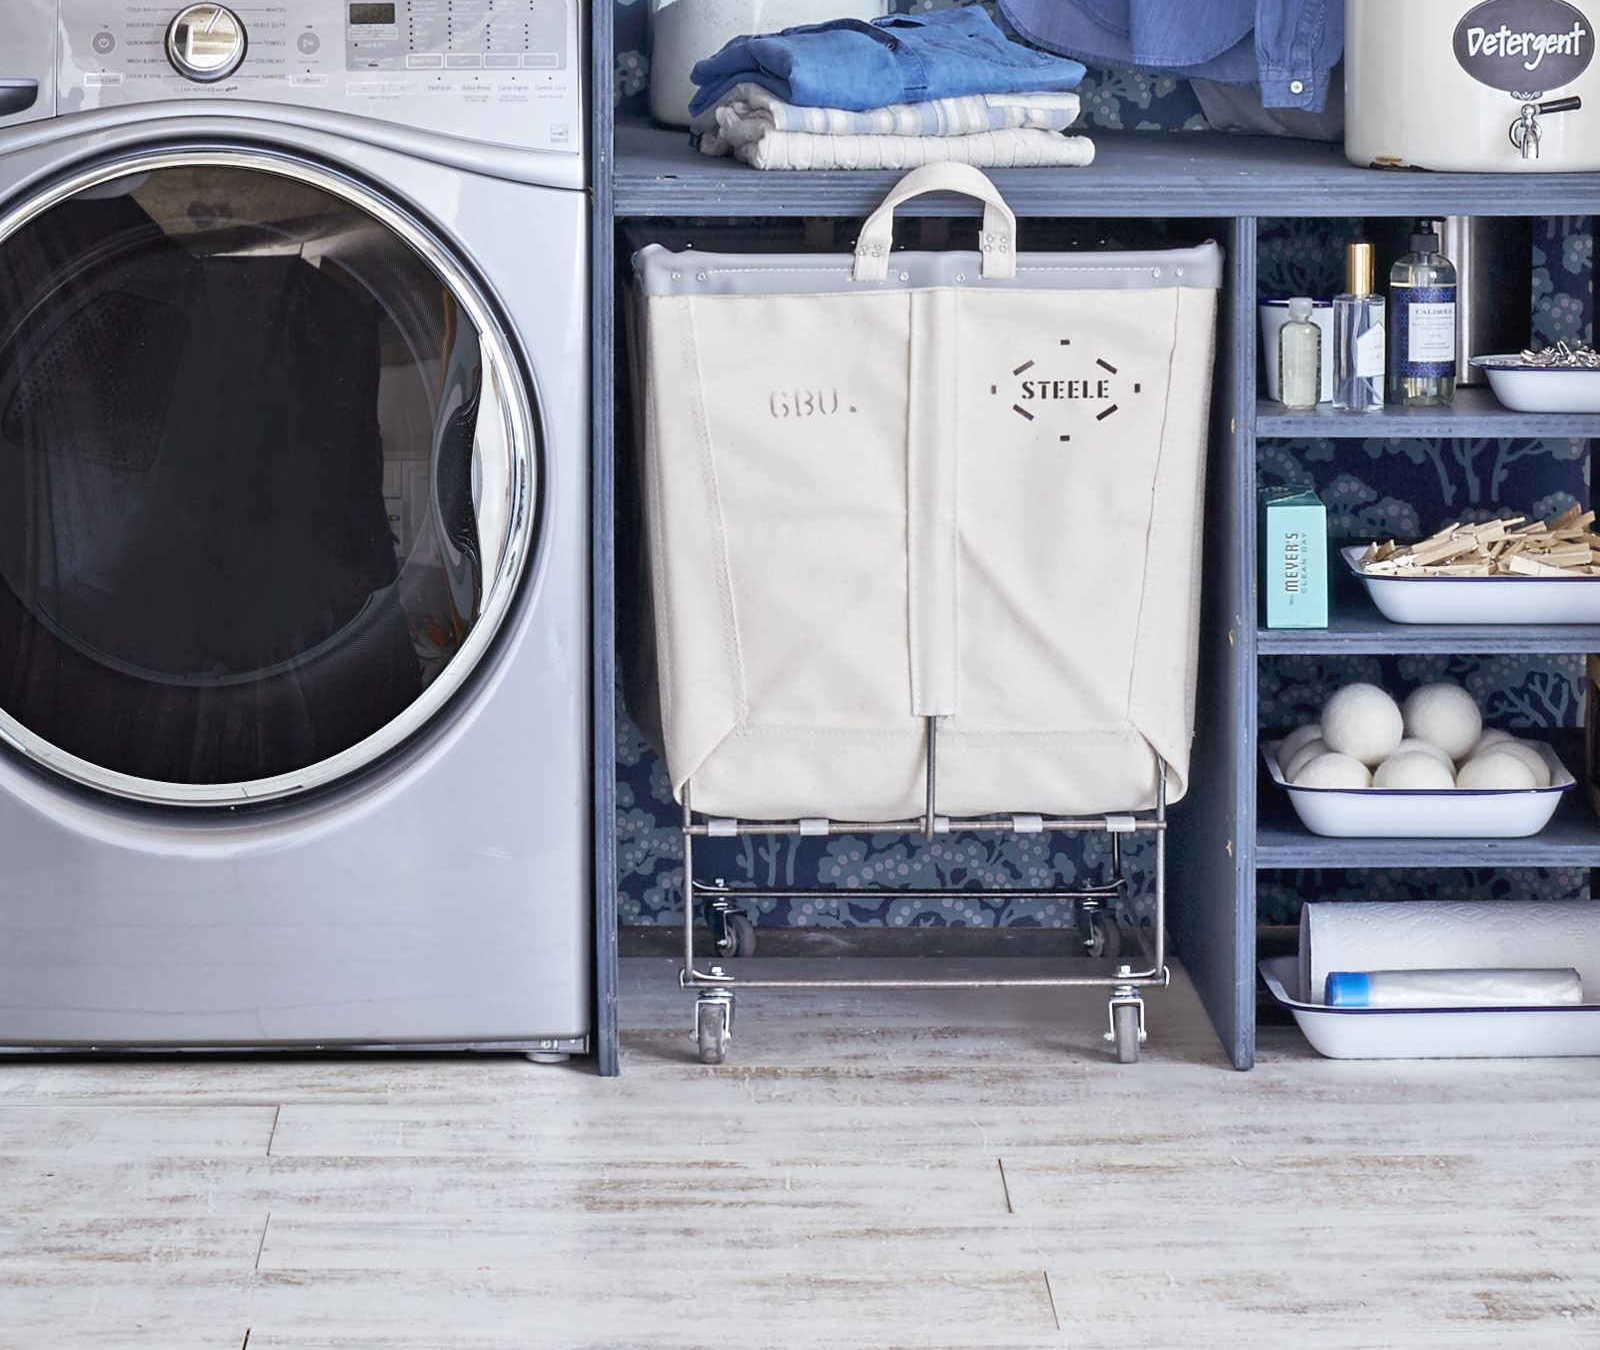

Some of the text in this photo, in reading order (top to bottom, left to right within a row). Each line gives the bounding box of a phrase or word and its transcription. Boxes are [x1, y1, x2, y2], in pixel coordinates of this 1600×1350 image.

[1466, 21, 1586, 71] Detergent
[1021, 380, 1109, 399] STEELE
[1285, 532, 1299, 592] MEYER'S
